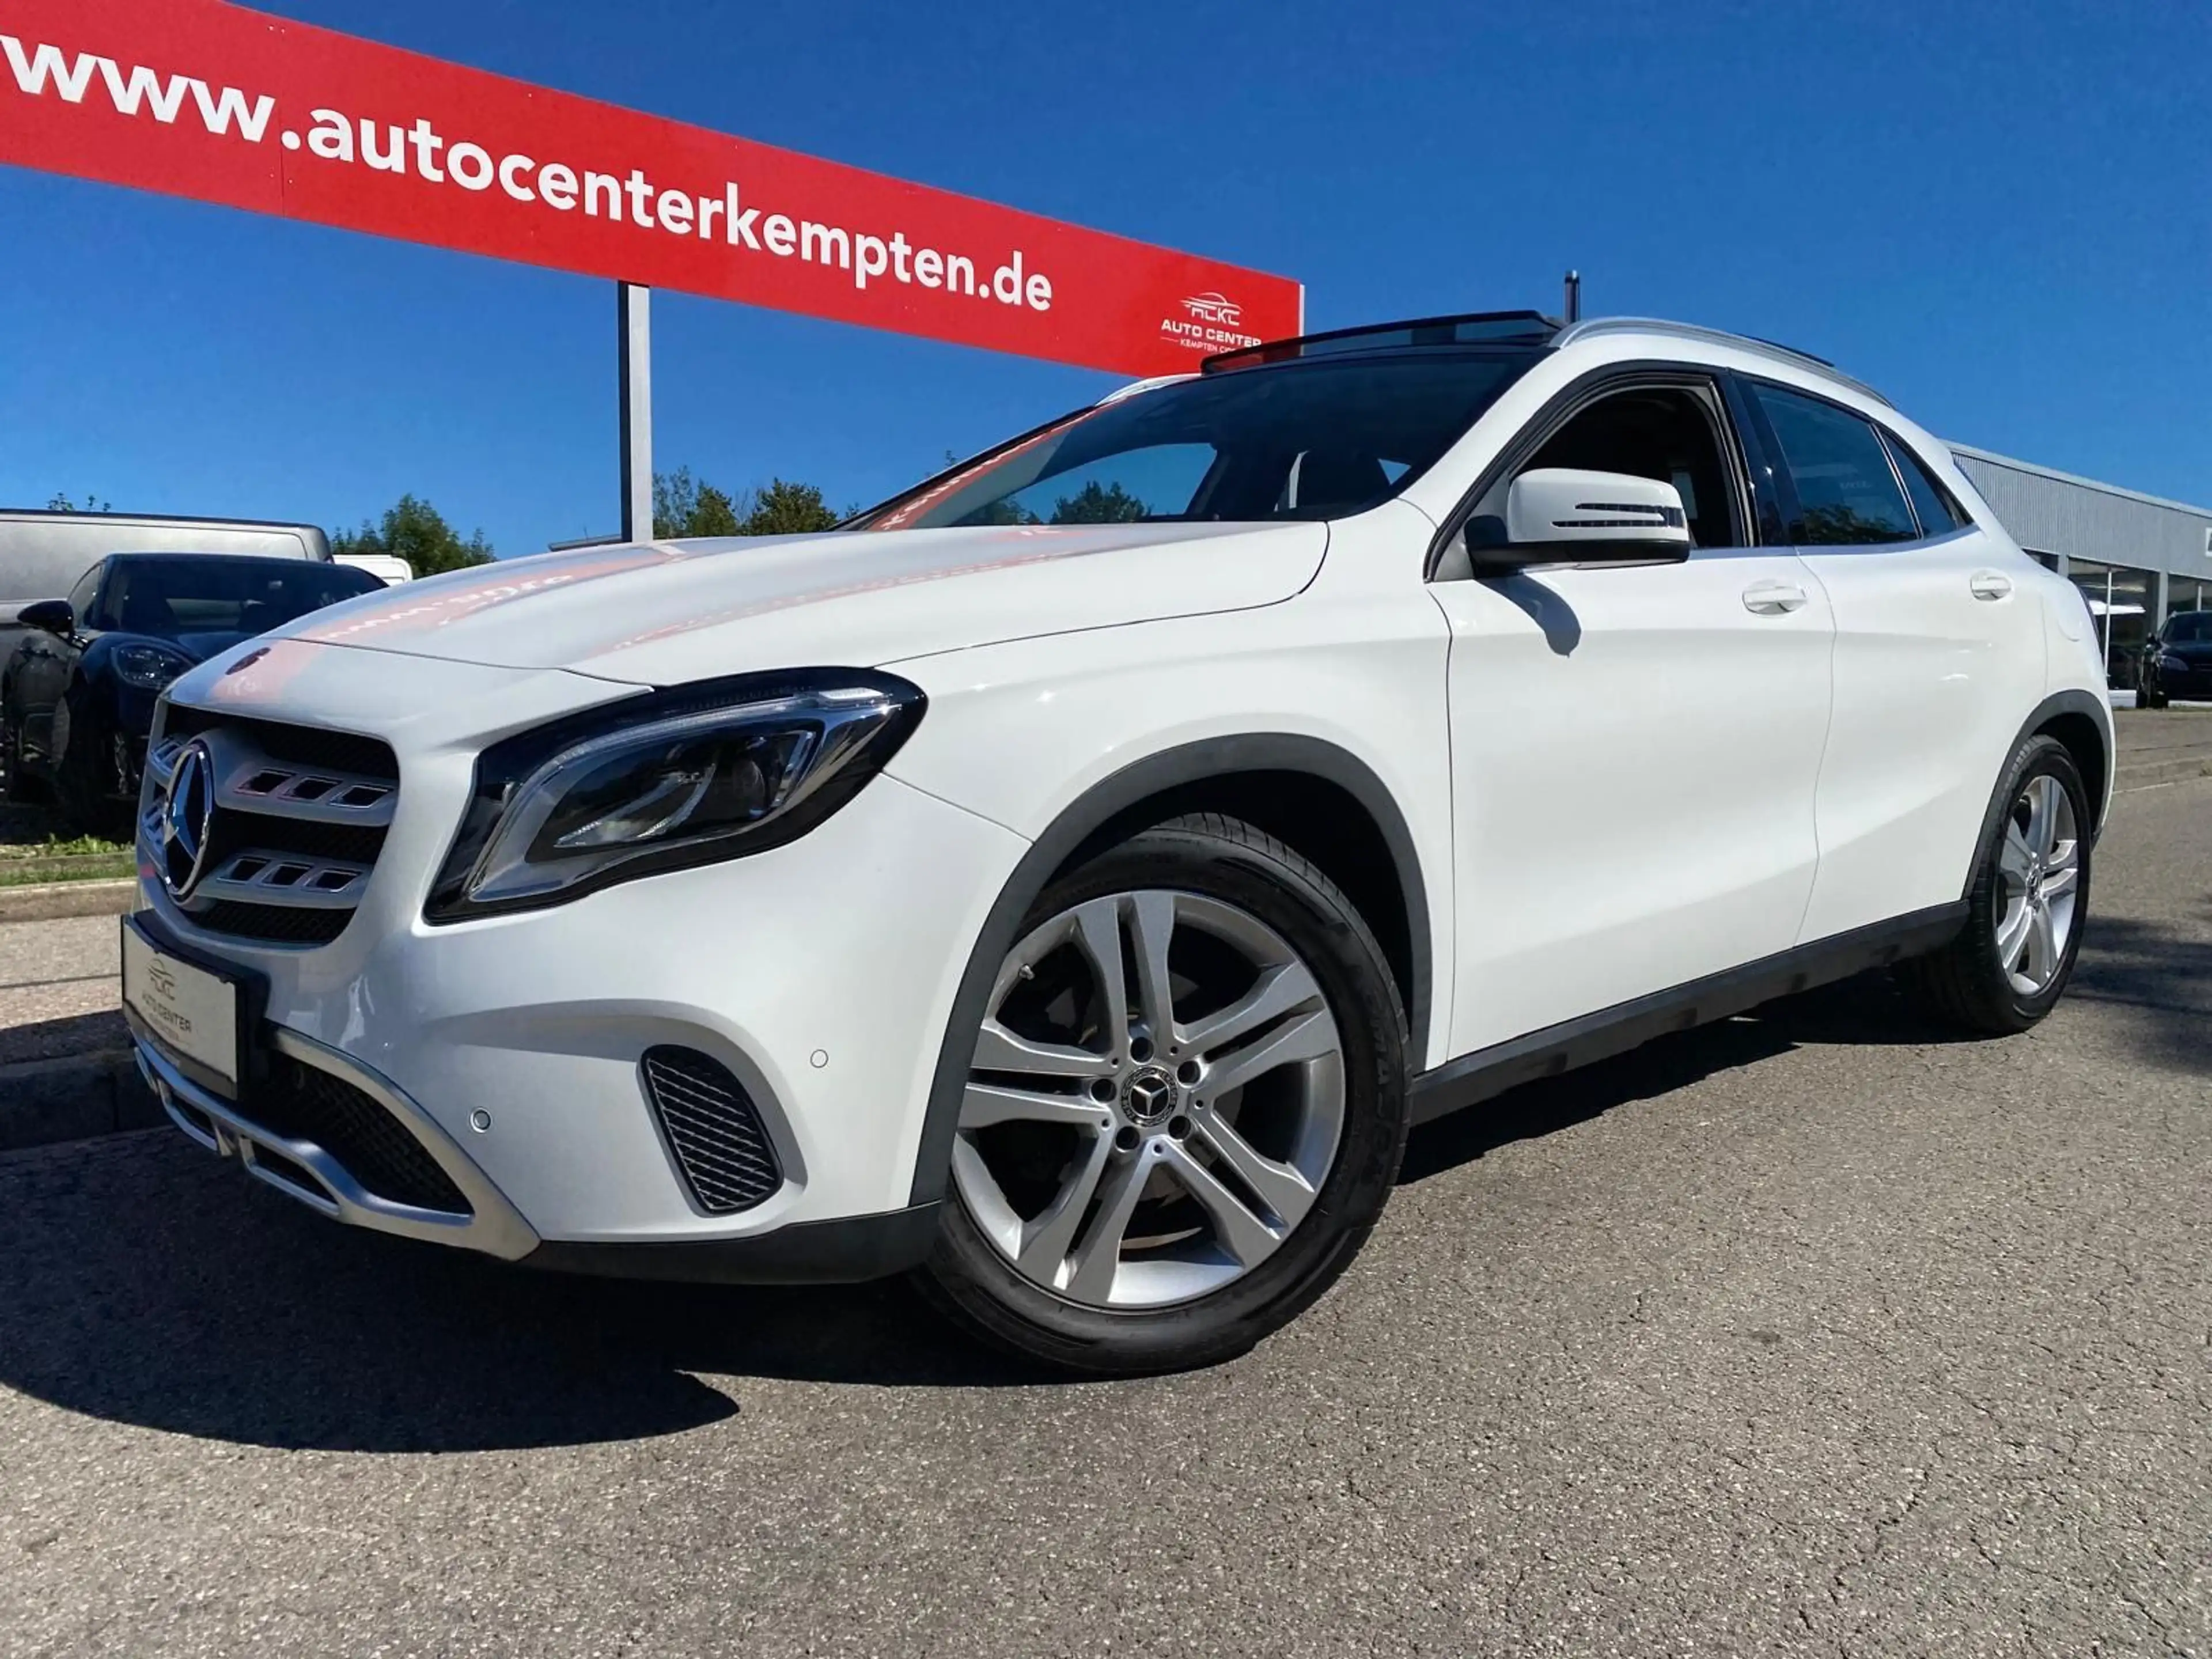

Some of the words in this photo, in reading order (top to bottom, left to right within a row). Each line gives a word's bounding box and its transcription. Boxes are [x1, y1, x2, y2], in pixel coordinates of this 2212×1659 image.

[0, 34, 1052, 311] www.autocenterkempten.de
[1161, 318, 1202, 338] AUTO
[1206, 328, 1262, 348] CENTER
[1180, 338, 1218, 353] KEMPTEN
